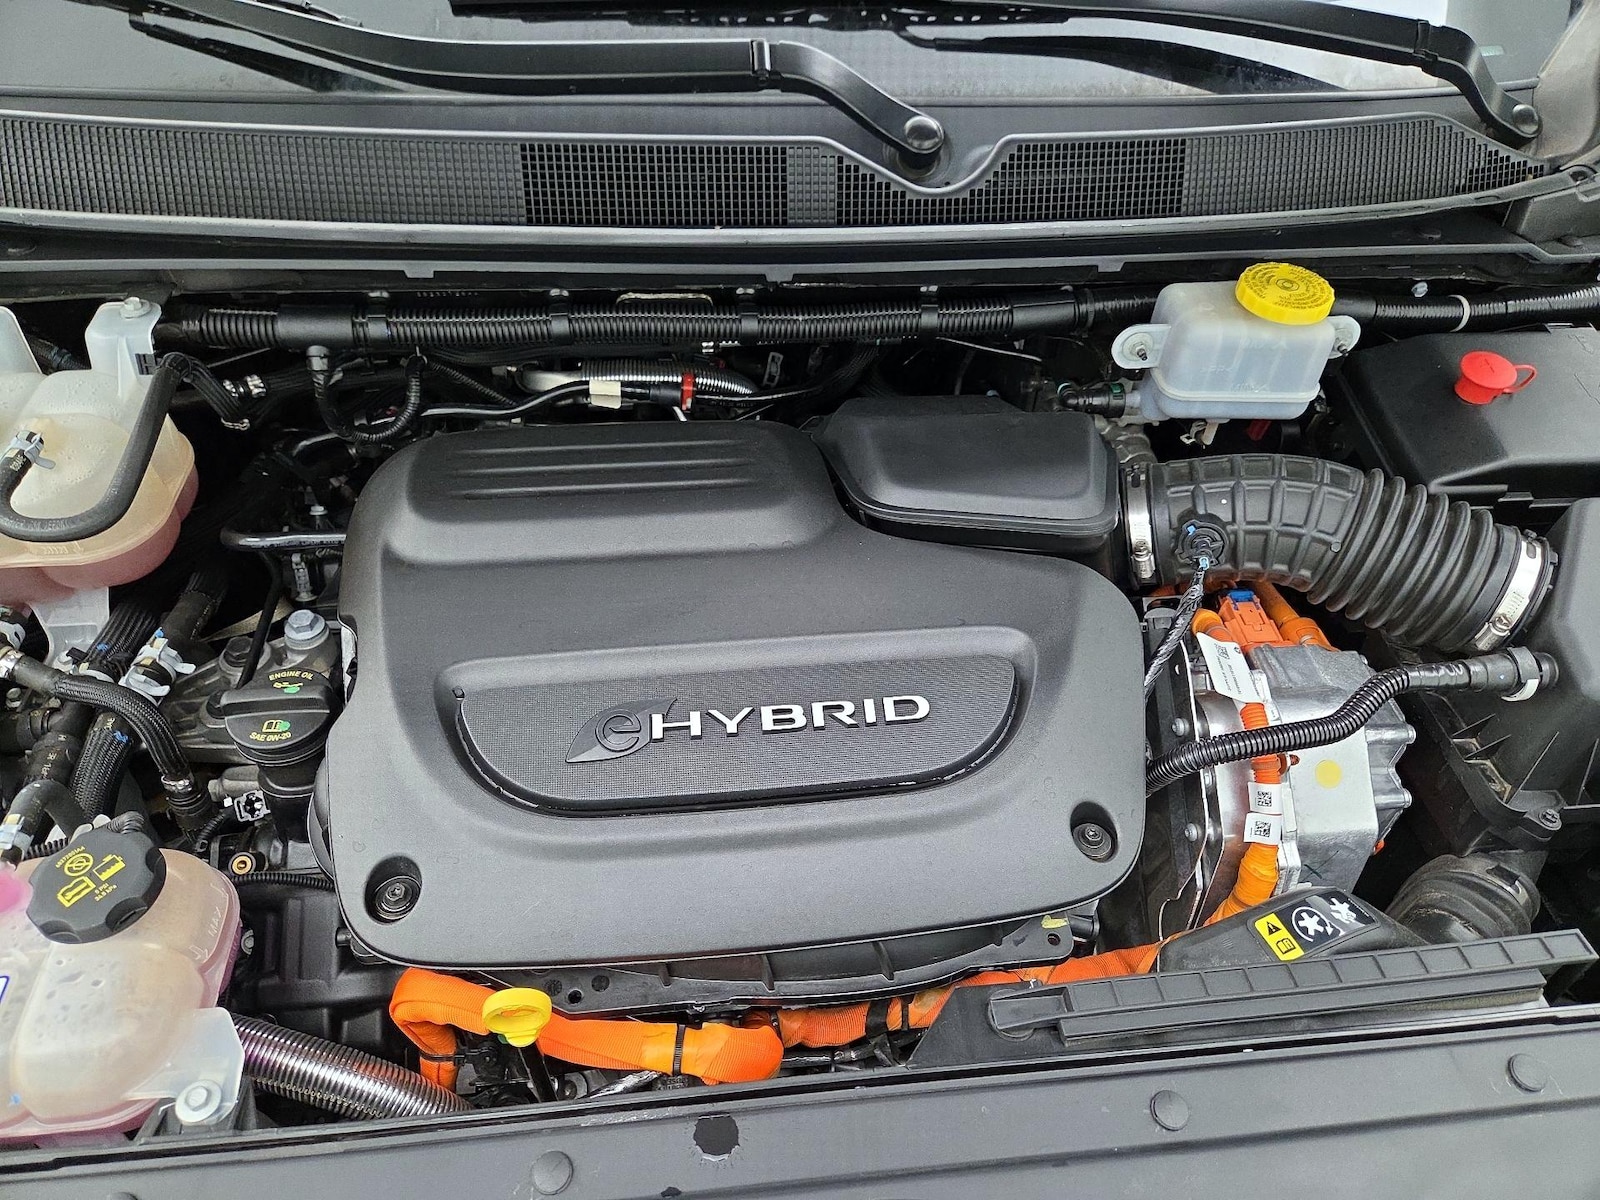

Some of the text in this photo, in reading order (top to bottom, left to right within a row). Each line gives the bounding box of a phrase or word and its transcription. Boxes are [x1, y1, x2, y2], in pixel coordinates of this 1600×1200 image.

[268, 671, 314, 681] ENGINE OIL
[249, 731, 292, 742] SAE 0W-20
